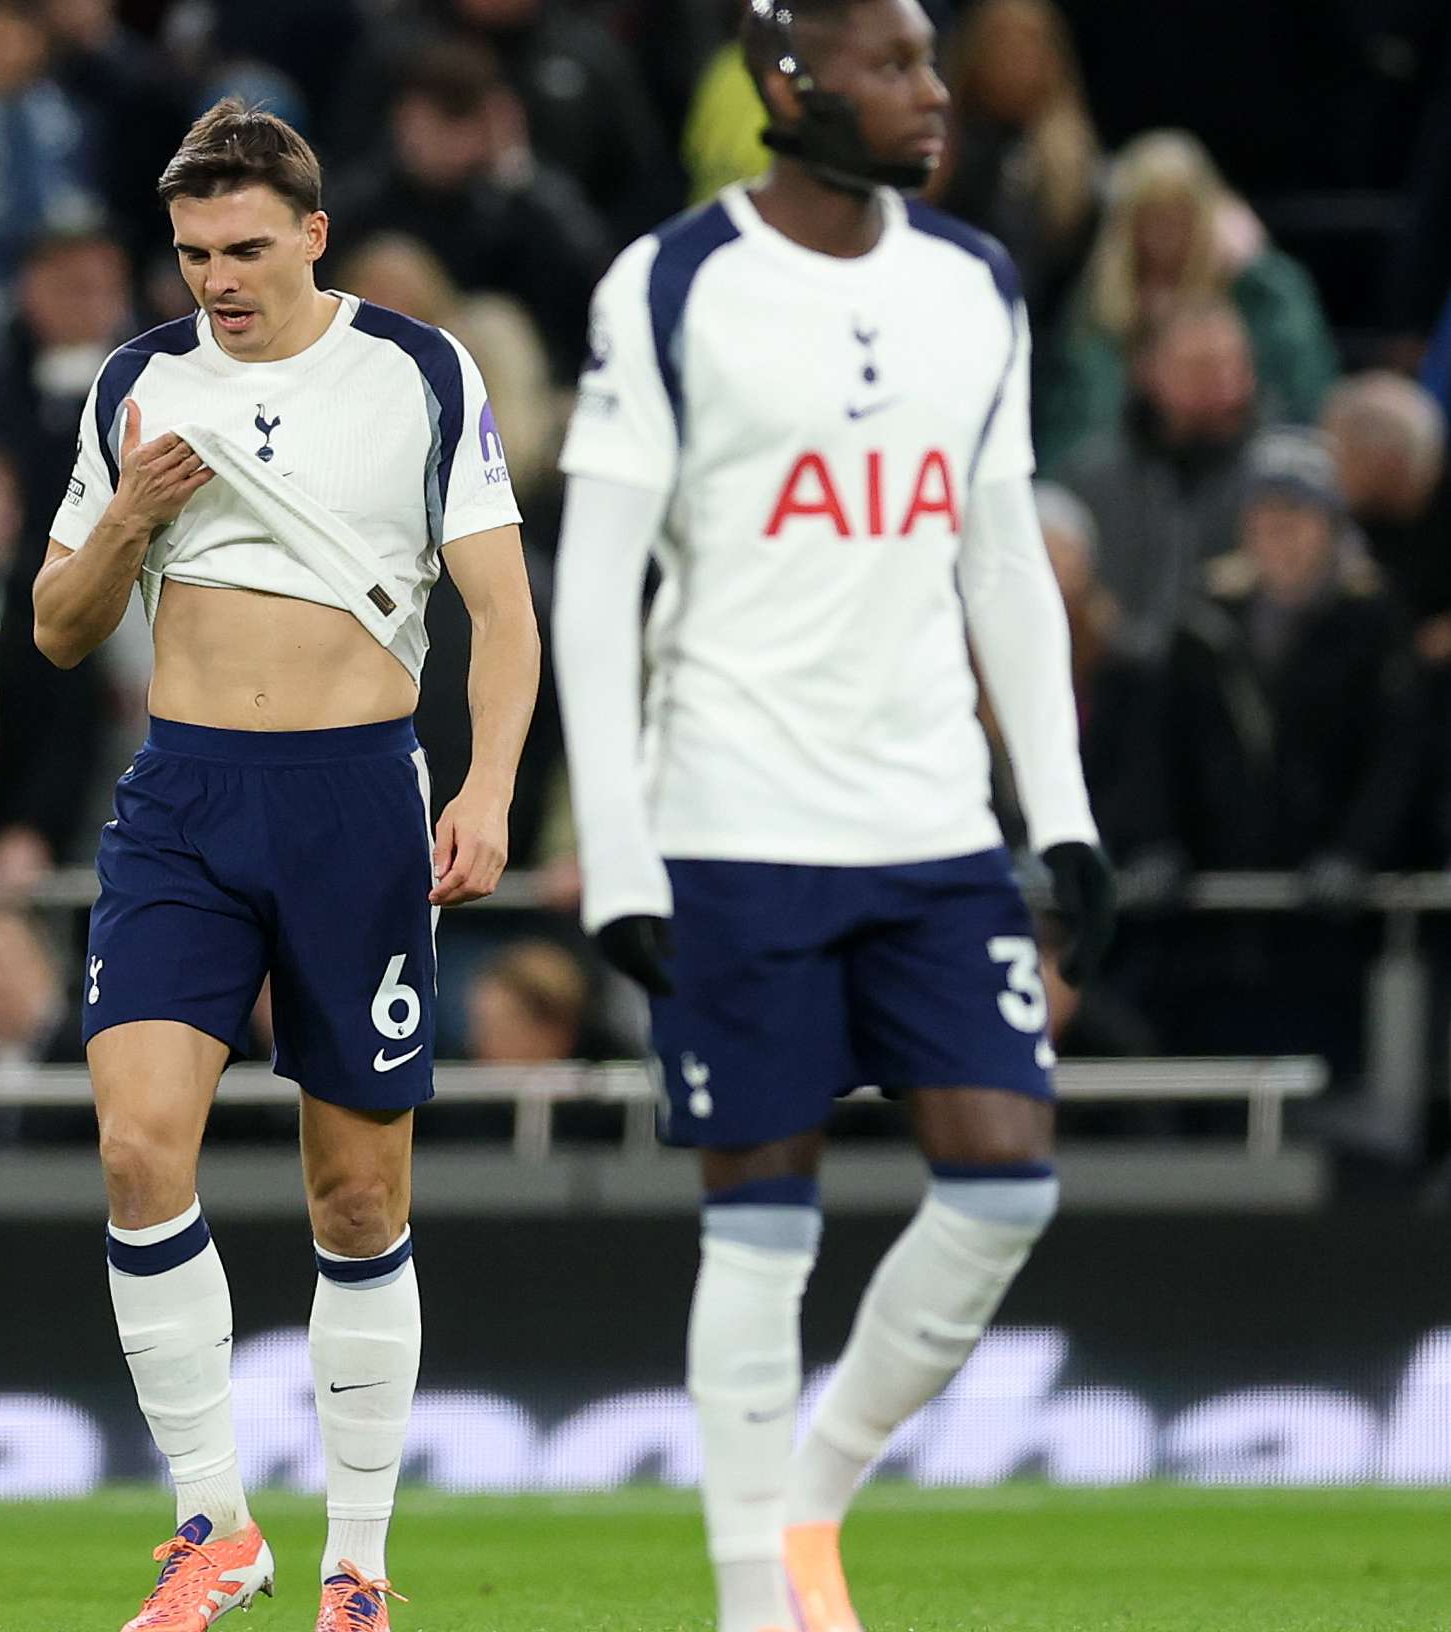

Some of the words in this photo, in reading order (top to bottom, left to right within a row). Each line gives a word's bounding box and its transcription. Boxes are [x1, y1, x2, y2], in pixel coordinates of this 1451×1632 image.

[763, 447, 960, 539] AIA
[371, 953, 421, 1040] 6
[986, 935, 1048, 1033] 3
